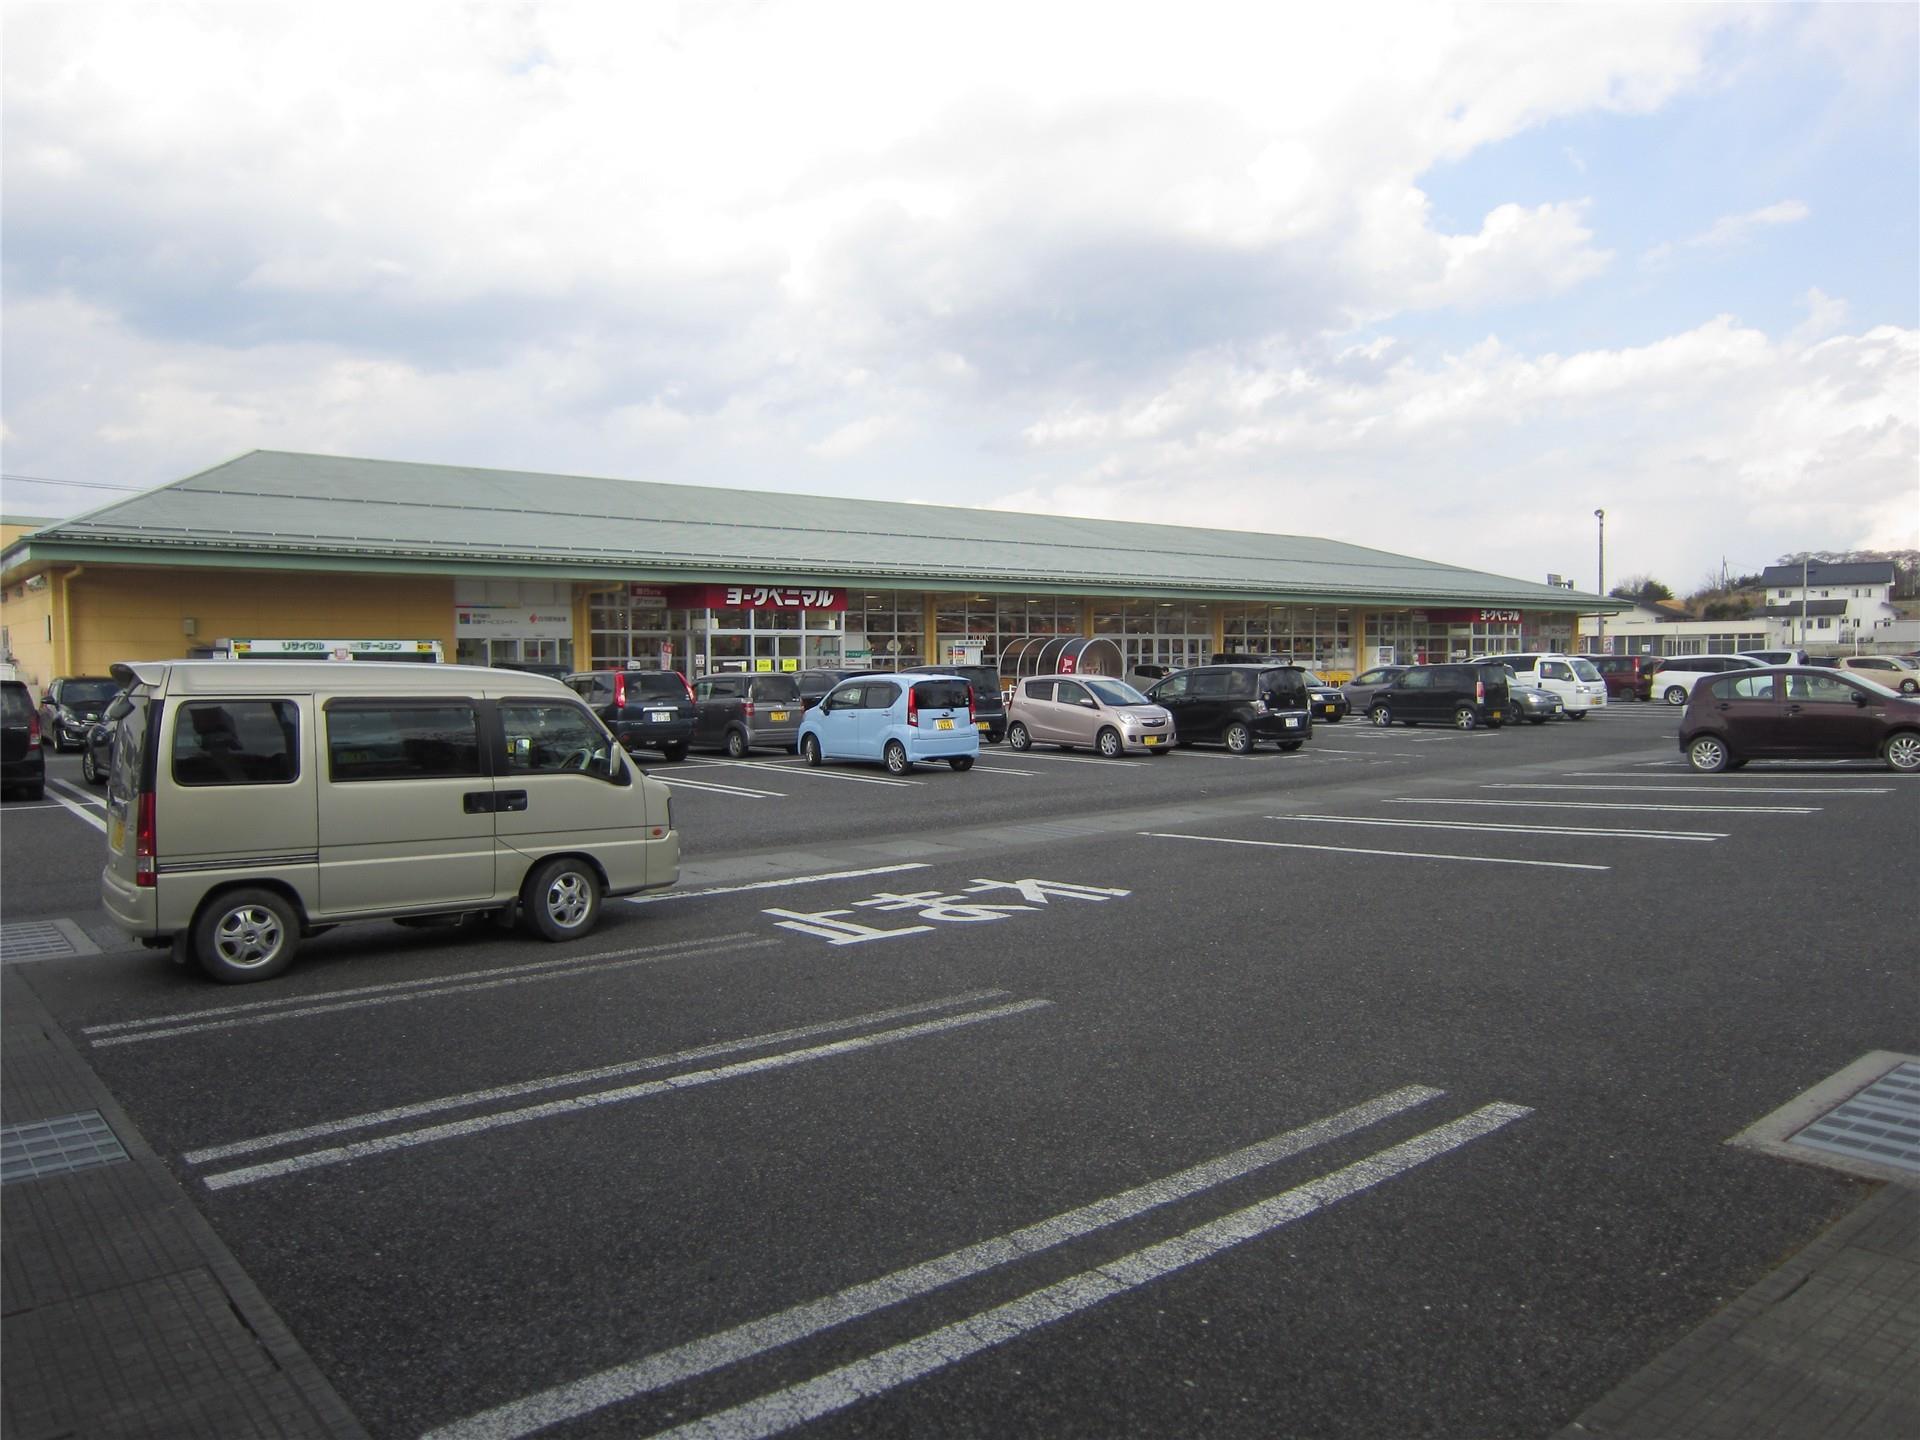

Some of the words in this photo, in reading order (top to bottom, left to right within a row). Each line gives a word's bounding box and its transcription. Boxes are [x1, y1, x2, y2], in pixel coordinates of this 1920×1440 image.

[726, 587, 834, 607] ヨークベニマル
[1480, 610, 1520, 622] ヨークベニマル
[281, 641, 325, 650] リサイクル
[352, 641, 402, 650] テーション
[761, 878, 1132, 946] 止まれ
